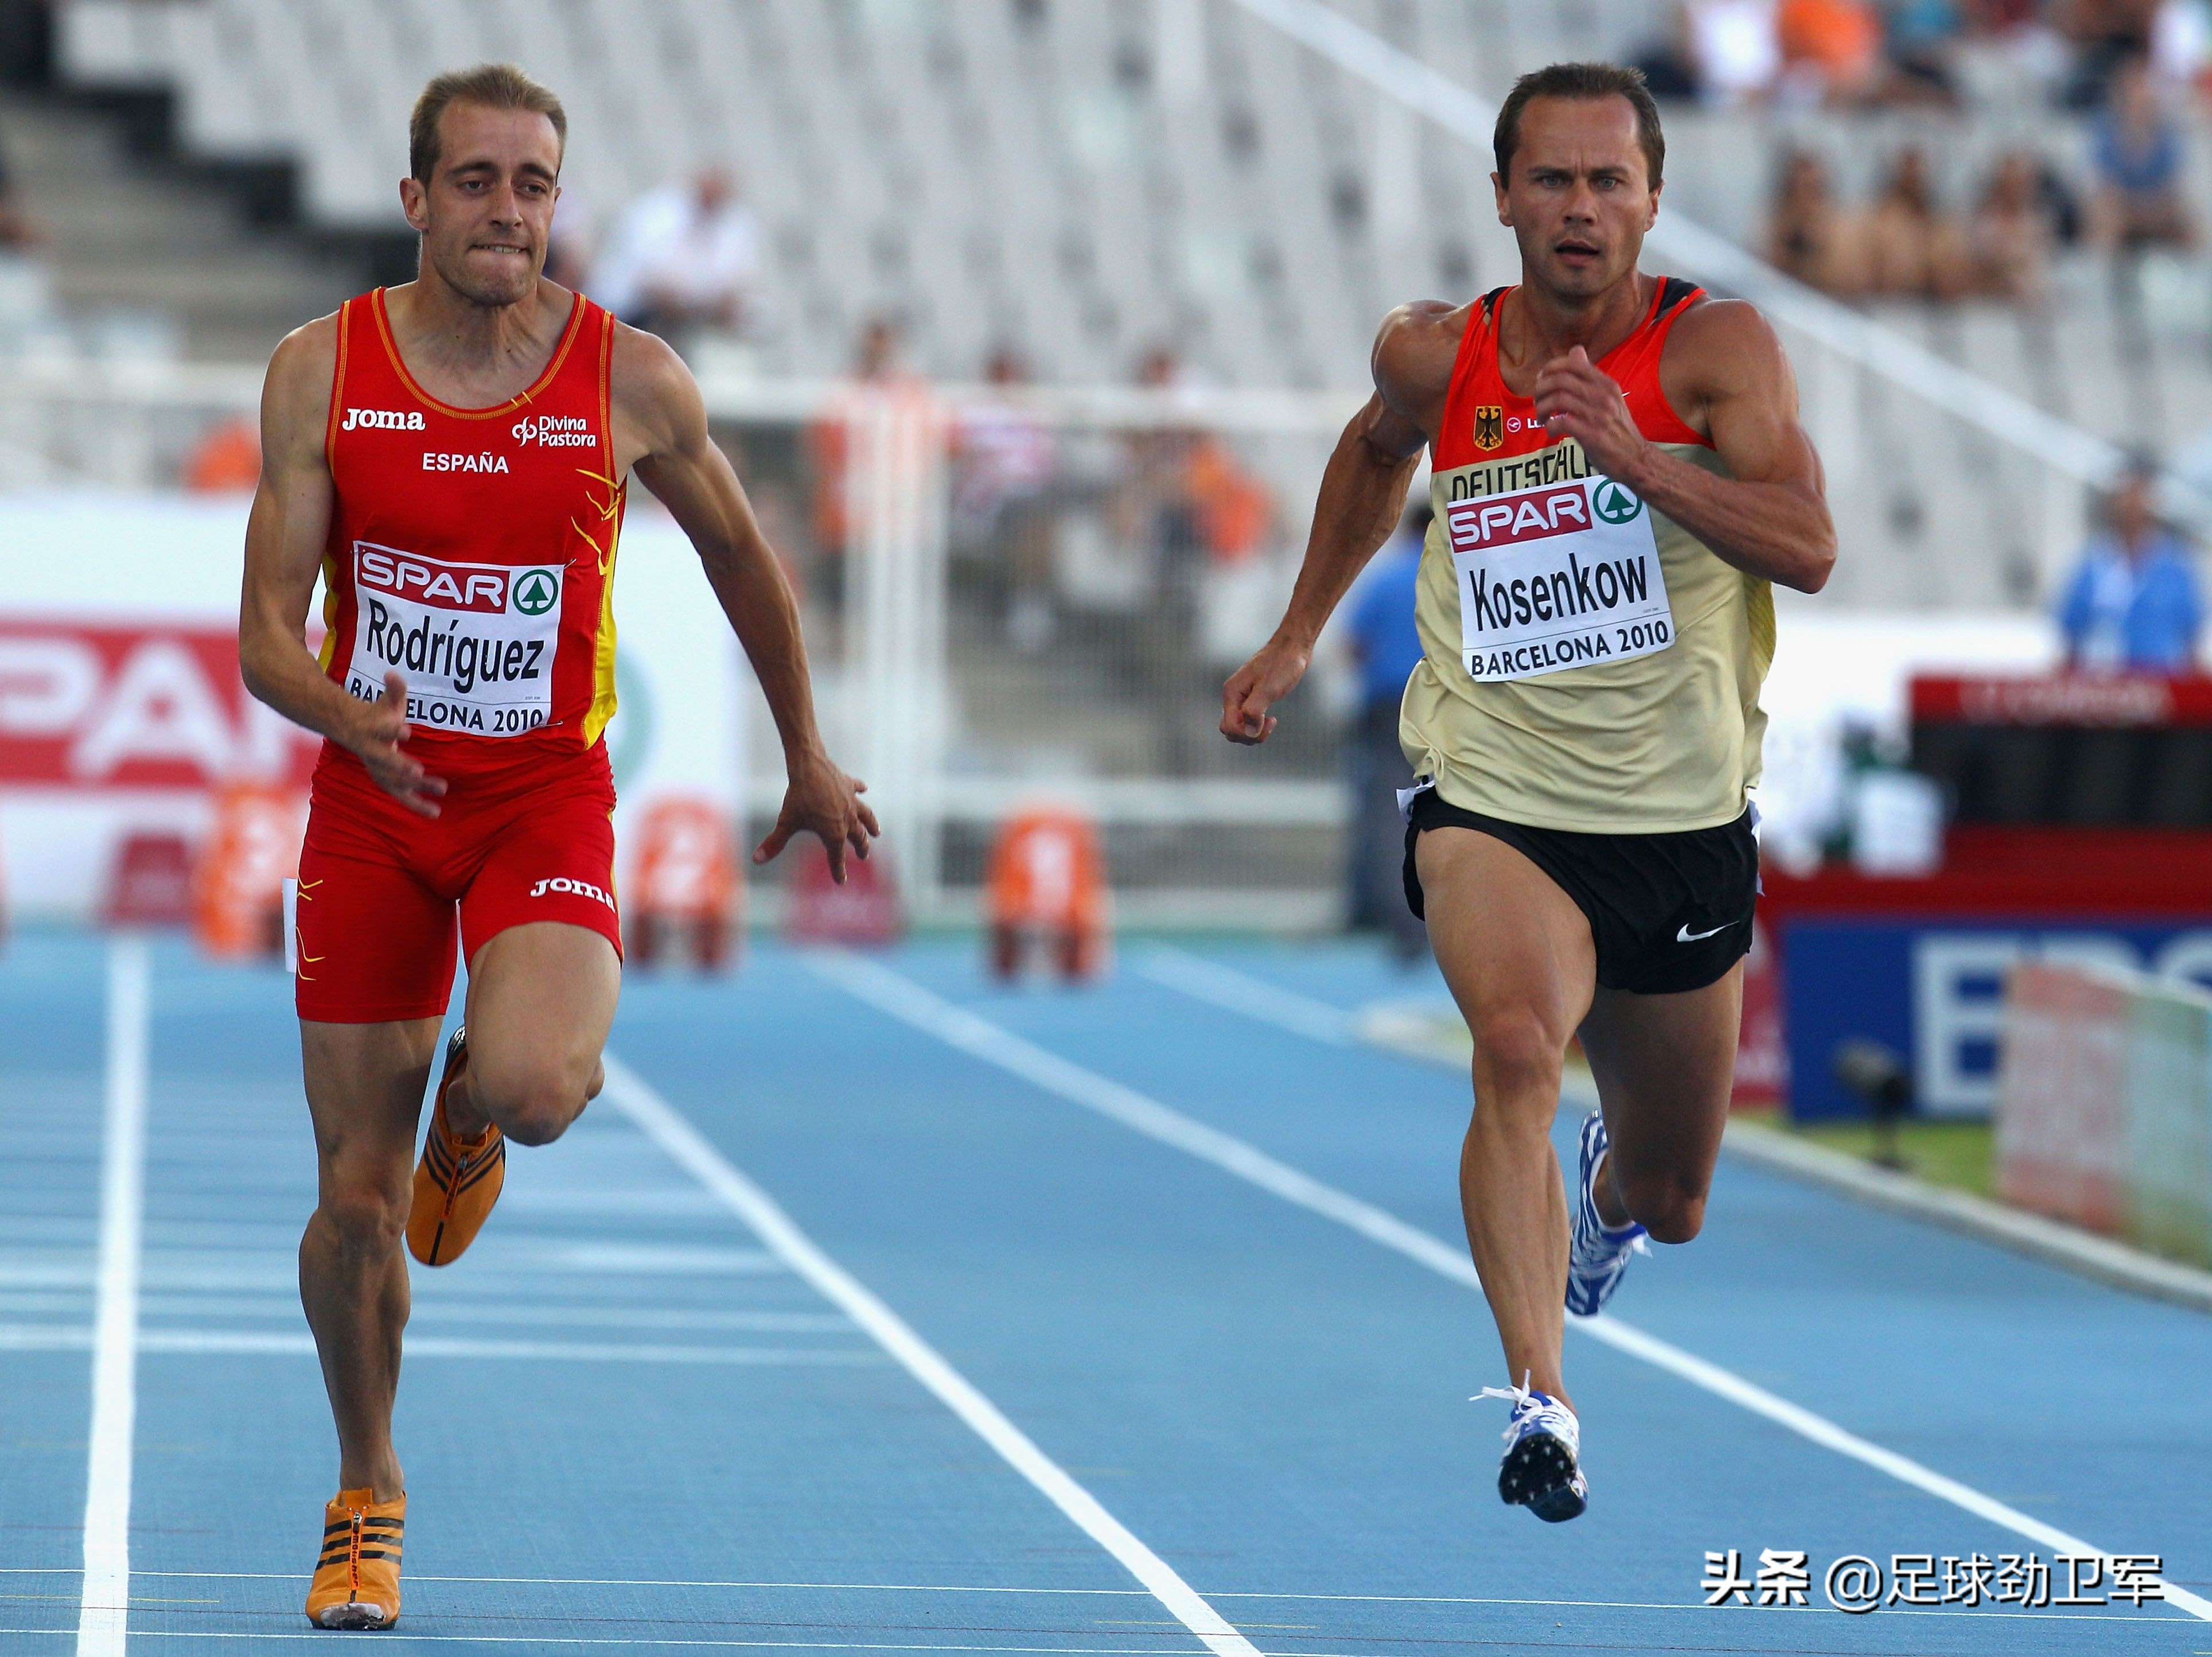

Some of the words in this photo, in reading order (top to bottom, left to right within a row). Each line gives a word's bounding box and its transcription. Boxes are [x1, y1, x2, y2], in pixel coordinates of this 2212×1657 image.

[342, 408, 426, 431] Joma
[539, 415, 587, 431] Divina
[539, 431, 596, 447] Pastora
[422, 452, 509, 473] ESPAÑA
[1449, 492, 1586, 545] SPAR
[362, 551, 504, 607] SPAR
[1469, 553, 1647, 631] Kosenkow
[367, 597, 544, 693] Rodríguez
[1471, 633, 1611, 675] BARCELONA
[1617, 620, 1669, 652] 2010
[350, 678, 484, 730] BAELONA
[493, 709, 543, 732] 2010
